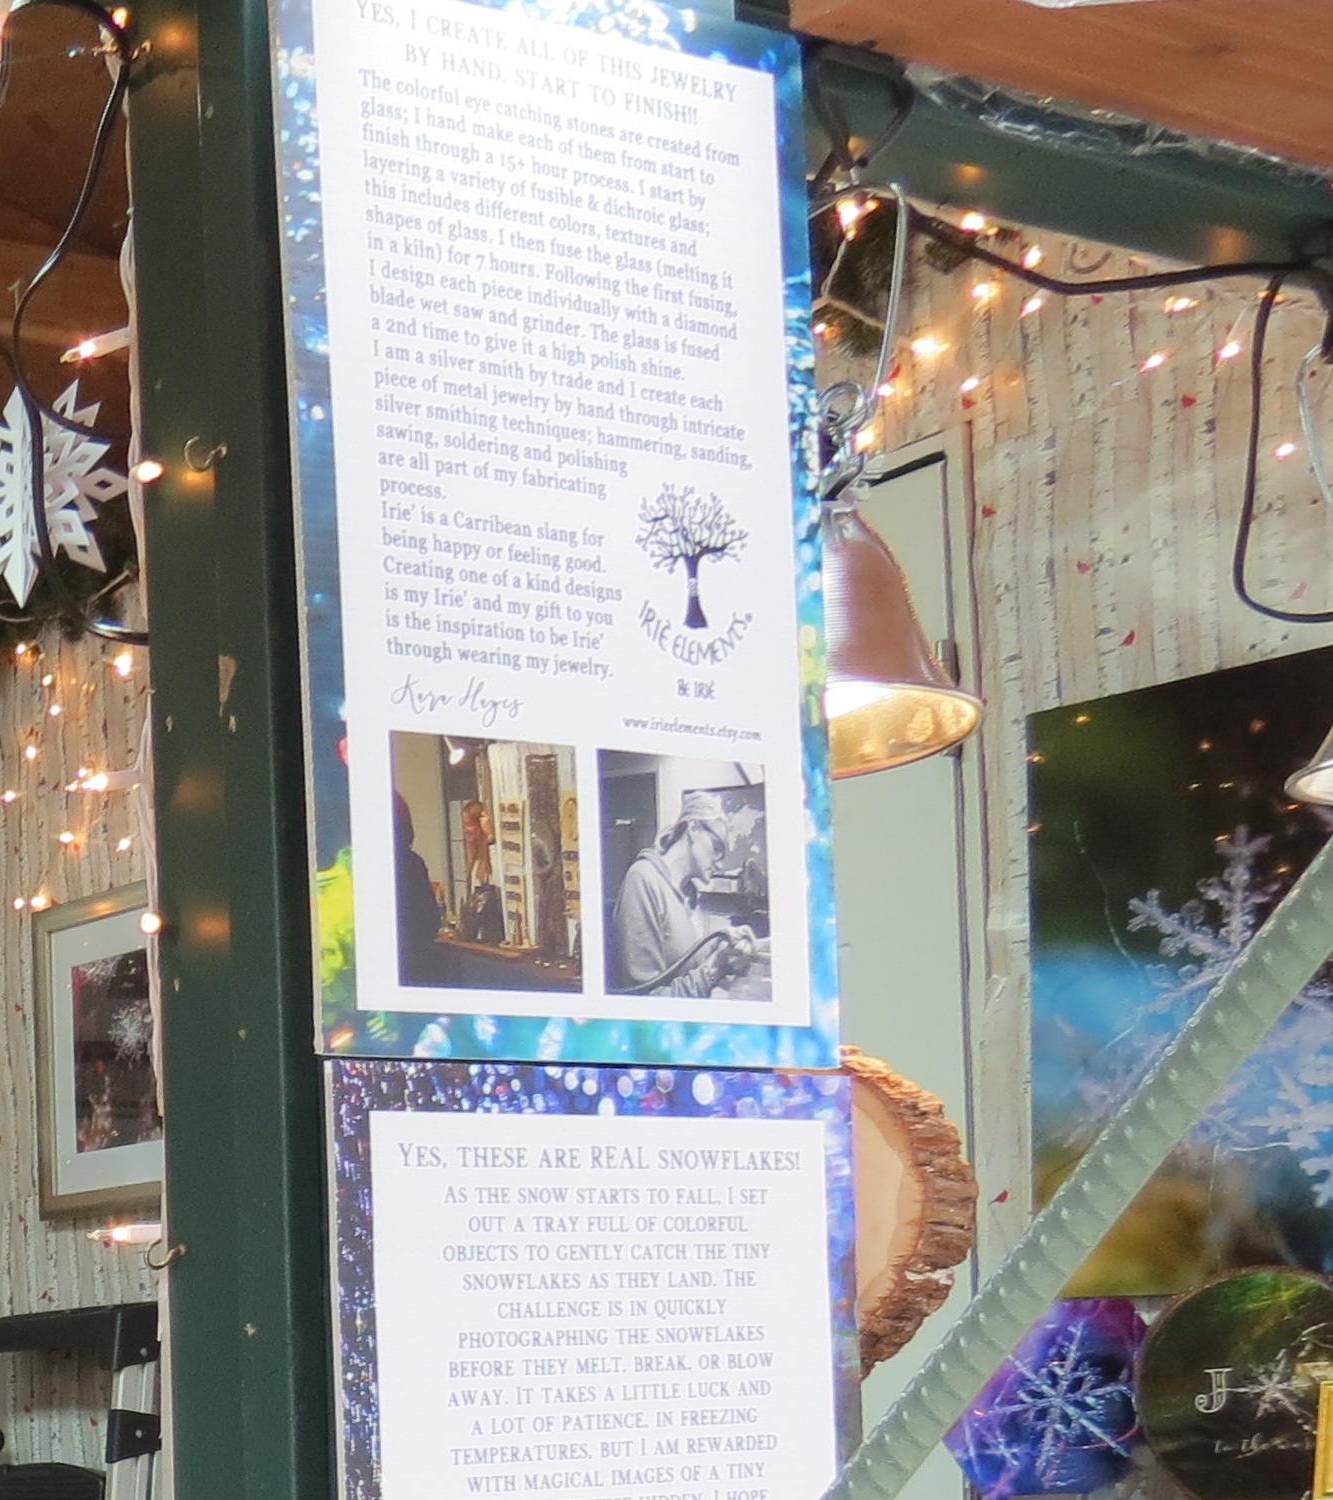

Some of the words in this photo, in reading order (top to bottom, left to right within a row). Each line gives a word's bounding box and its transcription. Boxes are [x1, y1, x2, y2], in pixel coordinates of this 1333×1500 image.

[357, 67, 391, 92] The
[395, 79, 459, 105] colorful
[464, 95, 490, 113] eye
[494, 102, 562, 132] catching
[566, 116, 615, 139] stones
[619, 128, 643, 145] are
[646, 134, 701, 159] created
[704, 142, 740, 167] from
[373, 367, 417, 390] piece
[421, 375, 437, 393] of
[441, 380, 488, 401] metal
[492, 384, 550, 414] jewelry
[553, 394, 573, 418] by
[575, 397, 615, 420] hand
[619, 405, 678, 434] through
[682, 414, 745, 441] intricate
[374, 393, 421, 417] silver
[425, 404, 498, 433] smithing
[501, 413, 592, 446] techniques;
[443, 431, 519, 462] soldering
[522, 444, 552, 462] and
[556, 448, 628, 478] polishing
[381, 526, 428, 555] being
[431, 533, 482, 561] happy
[485, 545, 503, 560] or
[507, 543, 561, 572] feeling
[564, 554, 606, 574] good.
[386, 635, 452, 663] through
[456, 647, 521, 671] wearing
[525, 655, 550, 674] my
[553, 653, 613, 681] jewelry.
[456, 1146, 528, 1168] THESE
[537, 1147, 581, 1169] ARE
[590, 1147, 650, 1169] REAL
[657, 1149, 800, 1171] SNOWFLAKES!
[444, 1185, 468, 1203] AS
[473, 1186, 511, 1204] THE
[516, 1186, 569, 1204] SNOW
[575, 1187, 640, 1207] STARTS
[644, 1187, 670, 1204] TO
[739, 1187, 768, 1204] SET
[442, 1244, 519, 1262] OBJECTS
[523, 1243, 550, 1261] TO
[555, 1243, 626, 1261] GENTLY
[630, 1243, 687, 1263] CATCH
[692, 1243, 727, 1260] THE
[730, 1242, 770, 1259] TINY
[462, 1271, 581, 1291] SNOWFLAKES
[587, 1271, 609, 1289] AS
[614, 1271, 661, 1288] THEY
[667, 1270, 717, 1288] LAND.
[722, 1268, 756, 1287] THE
[497, 1300, 601, 1319] CHALLENGE
[607, 1299, 624, 1317] IS
[629, 1299, 648, 1316] IN
[653, 1297, 726, 1319] QUICKLY
[457, 1328, 609, 1349] PHOTOGRAPHING
[614, 1327, 650, 1345] THE
[654, 1325, 764, 1343] SNOWFLAKES
[448, 1359, 515, 1378] BEFORE
[520, 1357, 568, 1376] THEY
[697, 1353, 720, 1370] OR
[726, 1351, 773, 1369] BLOW
[599, 1439, 634, 1458] BUT
[652, 1437, 680, 1455] AM
[685, 1433, 777, 1454] REWARDED
